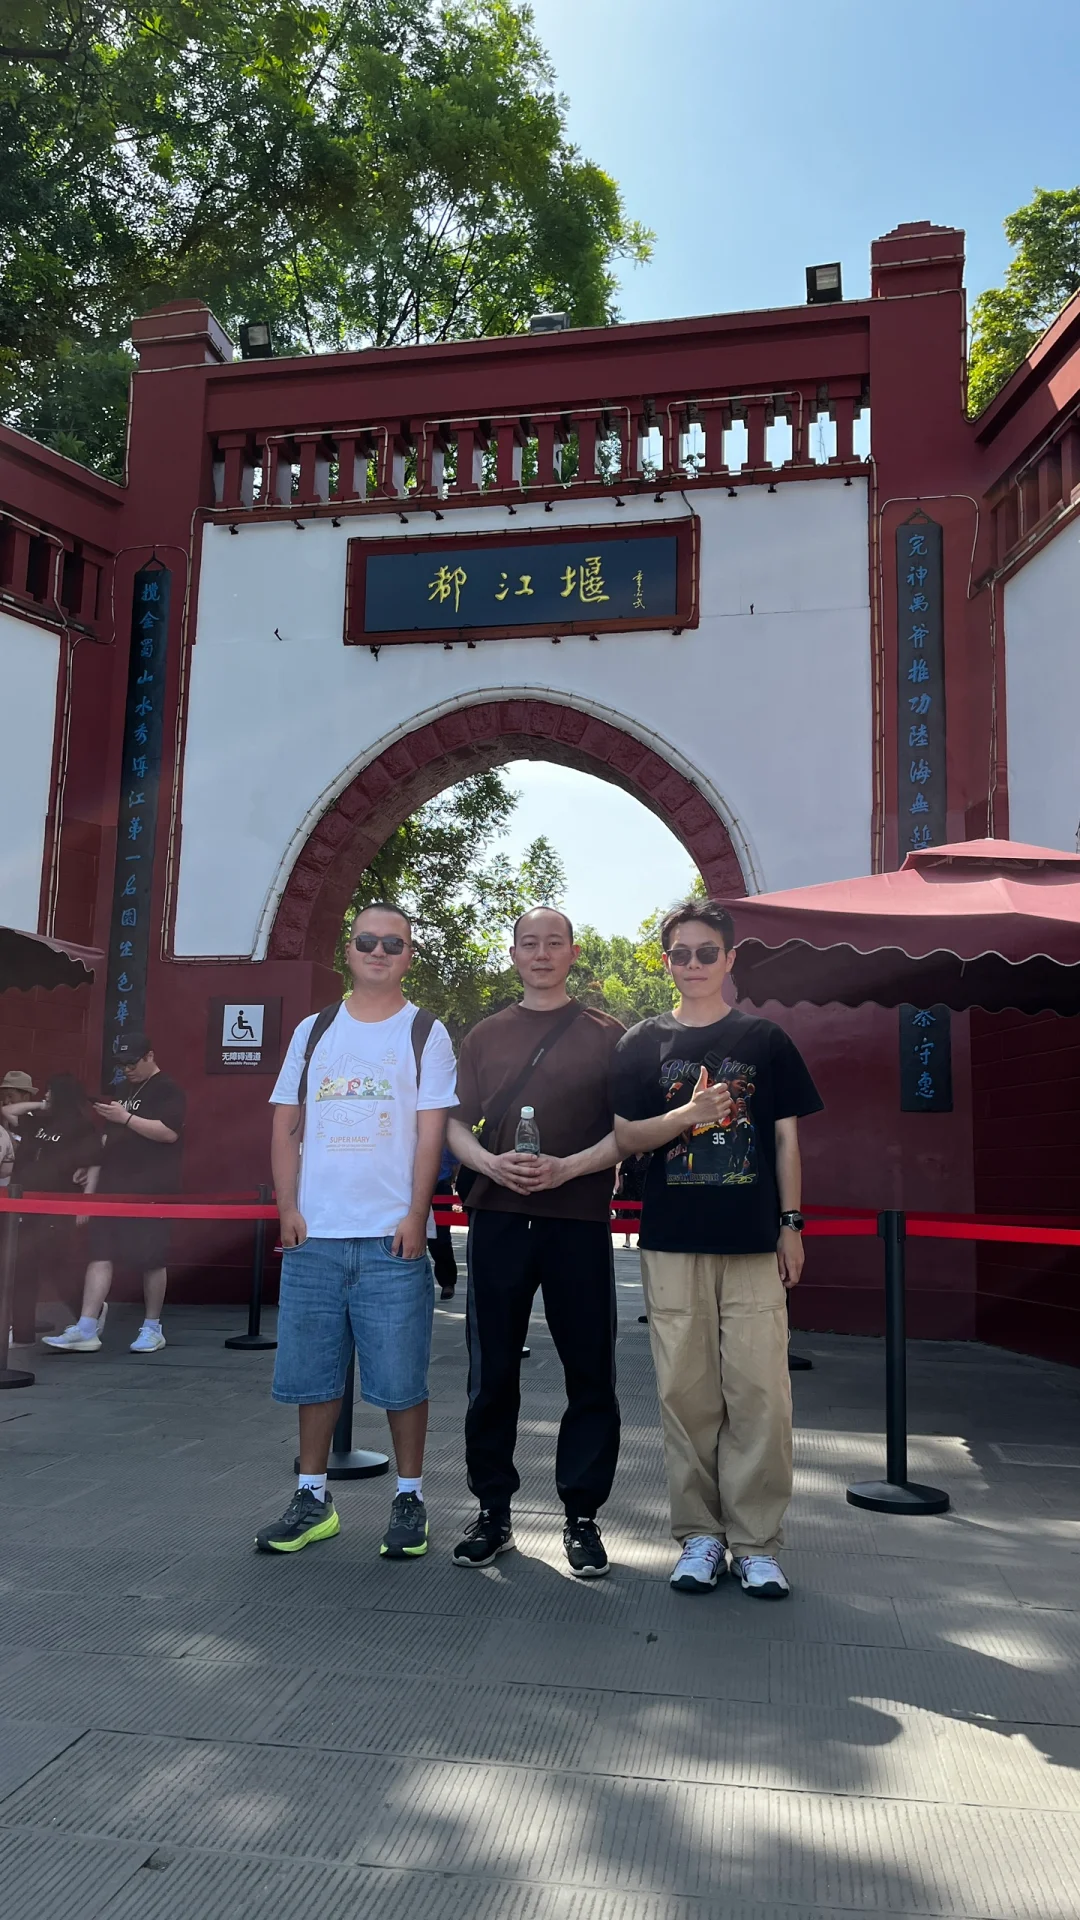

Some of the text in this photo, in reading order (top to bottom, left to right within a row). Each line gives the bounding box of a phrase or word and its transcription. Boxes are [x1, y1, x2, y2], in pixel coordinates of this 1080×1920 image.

[428, 556, 610, 613] 都江堰
[222, 1052, 261, 1061] 无障碍通道
[330, 1136, 350, 1144] SUPER
[712, 1132, 726, 1145] 35
